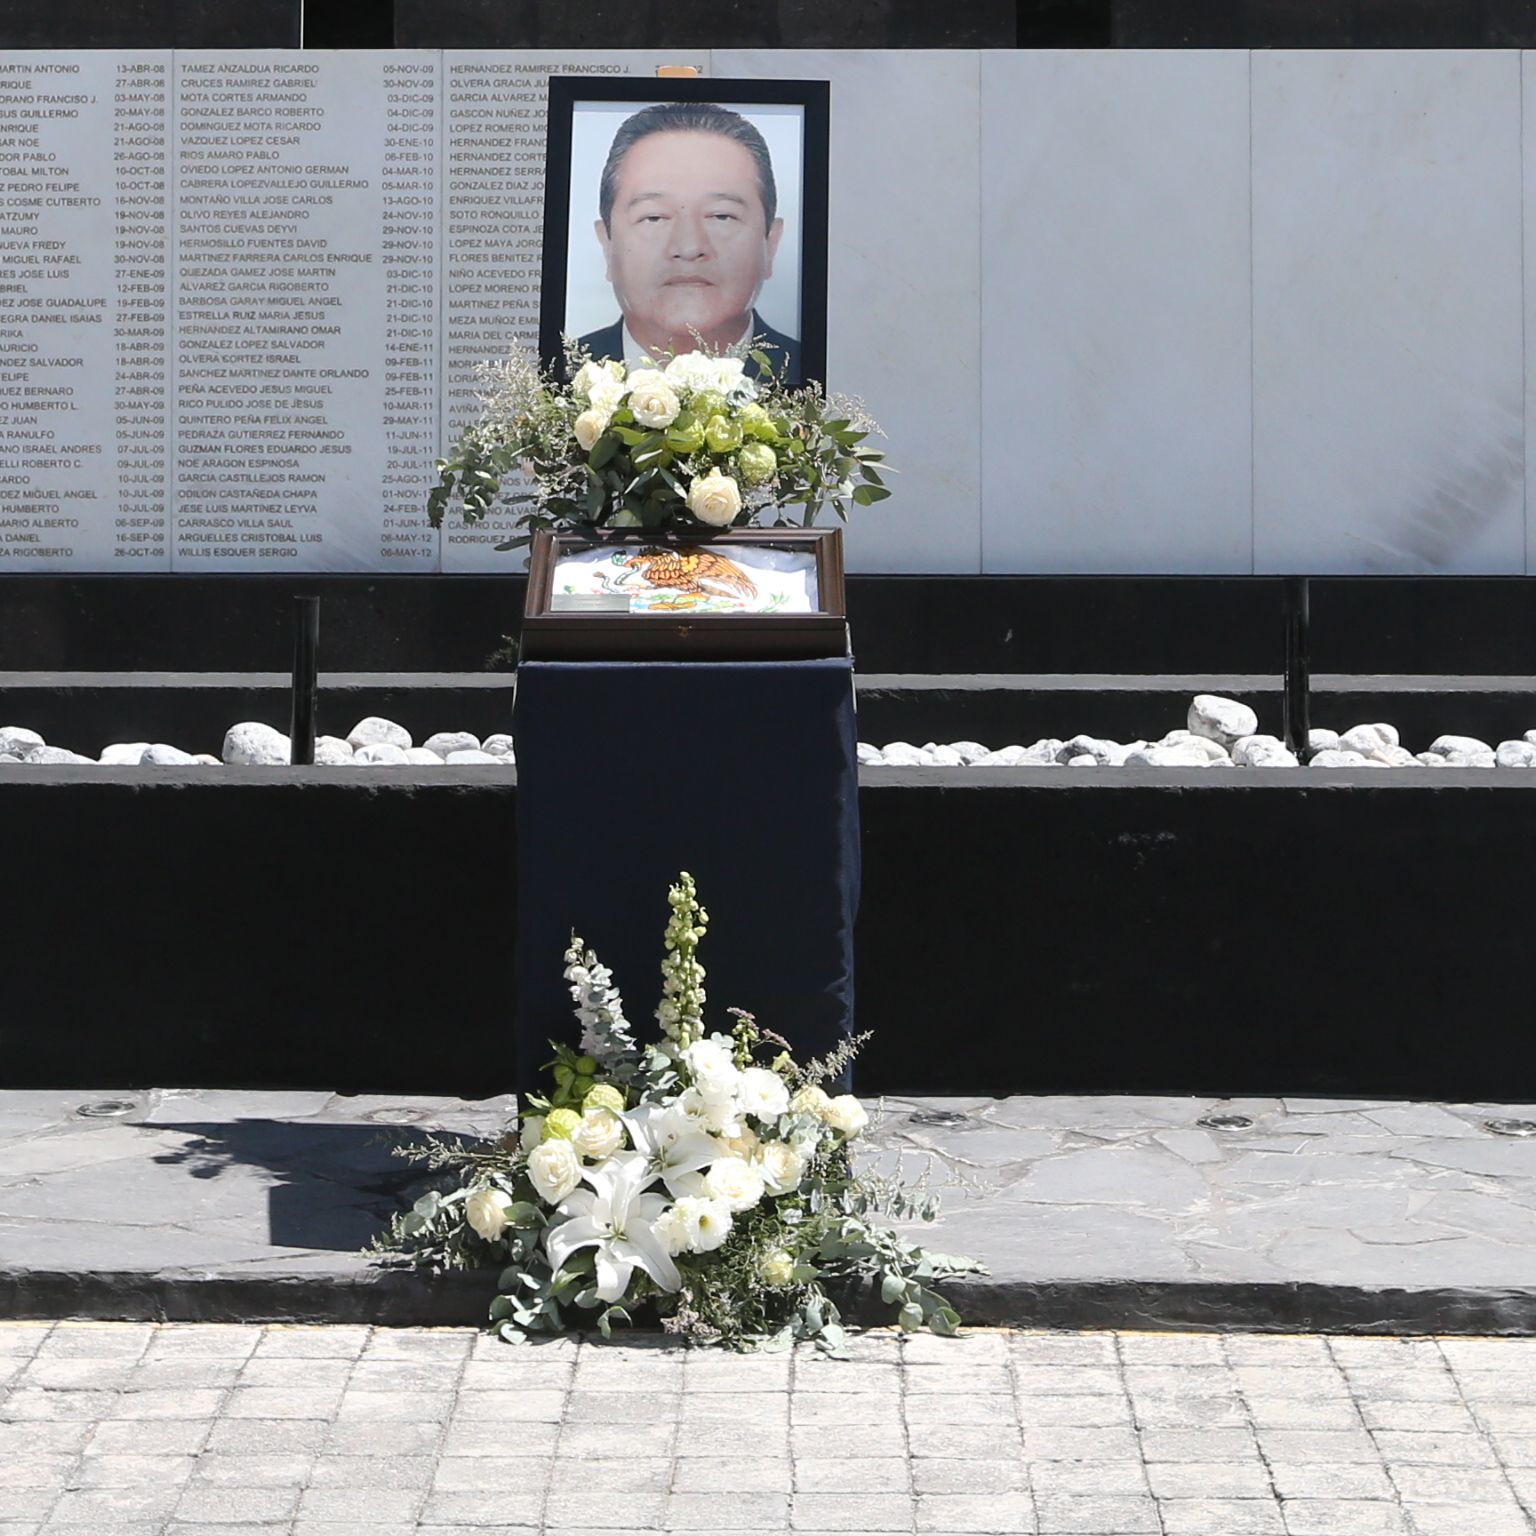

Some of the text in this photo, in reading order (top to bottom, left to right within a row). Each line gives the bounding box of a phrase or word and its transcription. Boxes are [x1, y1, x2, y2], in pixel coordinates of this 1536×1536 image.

[180, 64, 216, 74] TAMEZ
[216, 64, 272, 74] ANZALDUA
[272, 64, 321, 74] RICARDO
[449, 64, 513, 74] HERNANDEZ
[514, 64, 561, 74] RAMIREZ
[561, 64, 622, 74] FRANCISCO
[179, 78, 224, 88] CRUCES
[224, 78, 272, 88] RAMIREZ
[272, 78, 318, 88] GABRIEL
[179, 93, 211, 102] MOTA
[210, 93, 254, 102] CORTES
[255, 93, 309, 102] ARMANDO
[449, 93, 538, 102] GARCIA ALVAREZ
[449, 107, 532, 119] GASCON NUÑEZ
[448, 123, 531, 133] LOPEZ ROMERO
[448, 181, 530, 191] GONZALEZ DIAZ
[449, 210, 541, 220] SOTO RONQUILLO
[0, 226, 39, 236] MAURO
[448, 224, 532, 234] ESPINOZA COTA
[448, 267, 527, 279] NIÑO ACEVEDO
[448, 284, 531, 294] LOPEZ MORENO
[177, 473, 219, 483] GARCIA
[217, 473, 287, 483] CASTILLEJOS
[287, 473, 327, 483] RAMON
[1, 504, 61, 514] HUMBERTO
[177, 547, 212, 557] WILLIS
[212, 547, 257, 557] ESQUER
[258, 547, 299, 557] SERGIO
